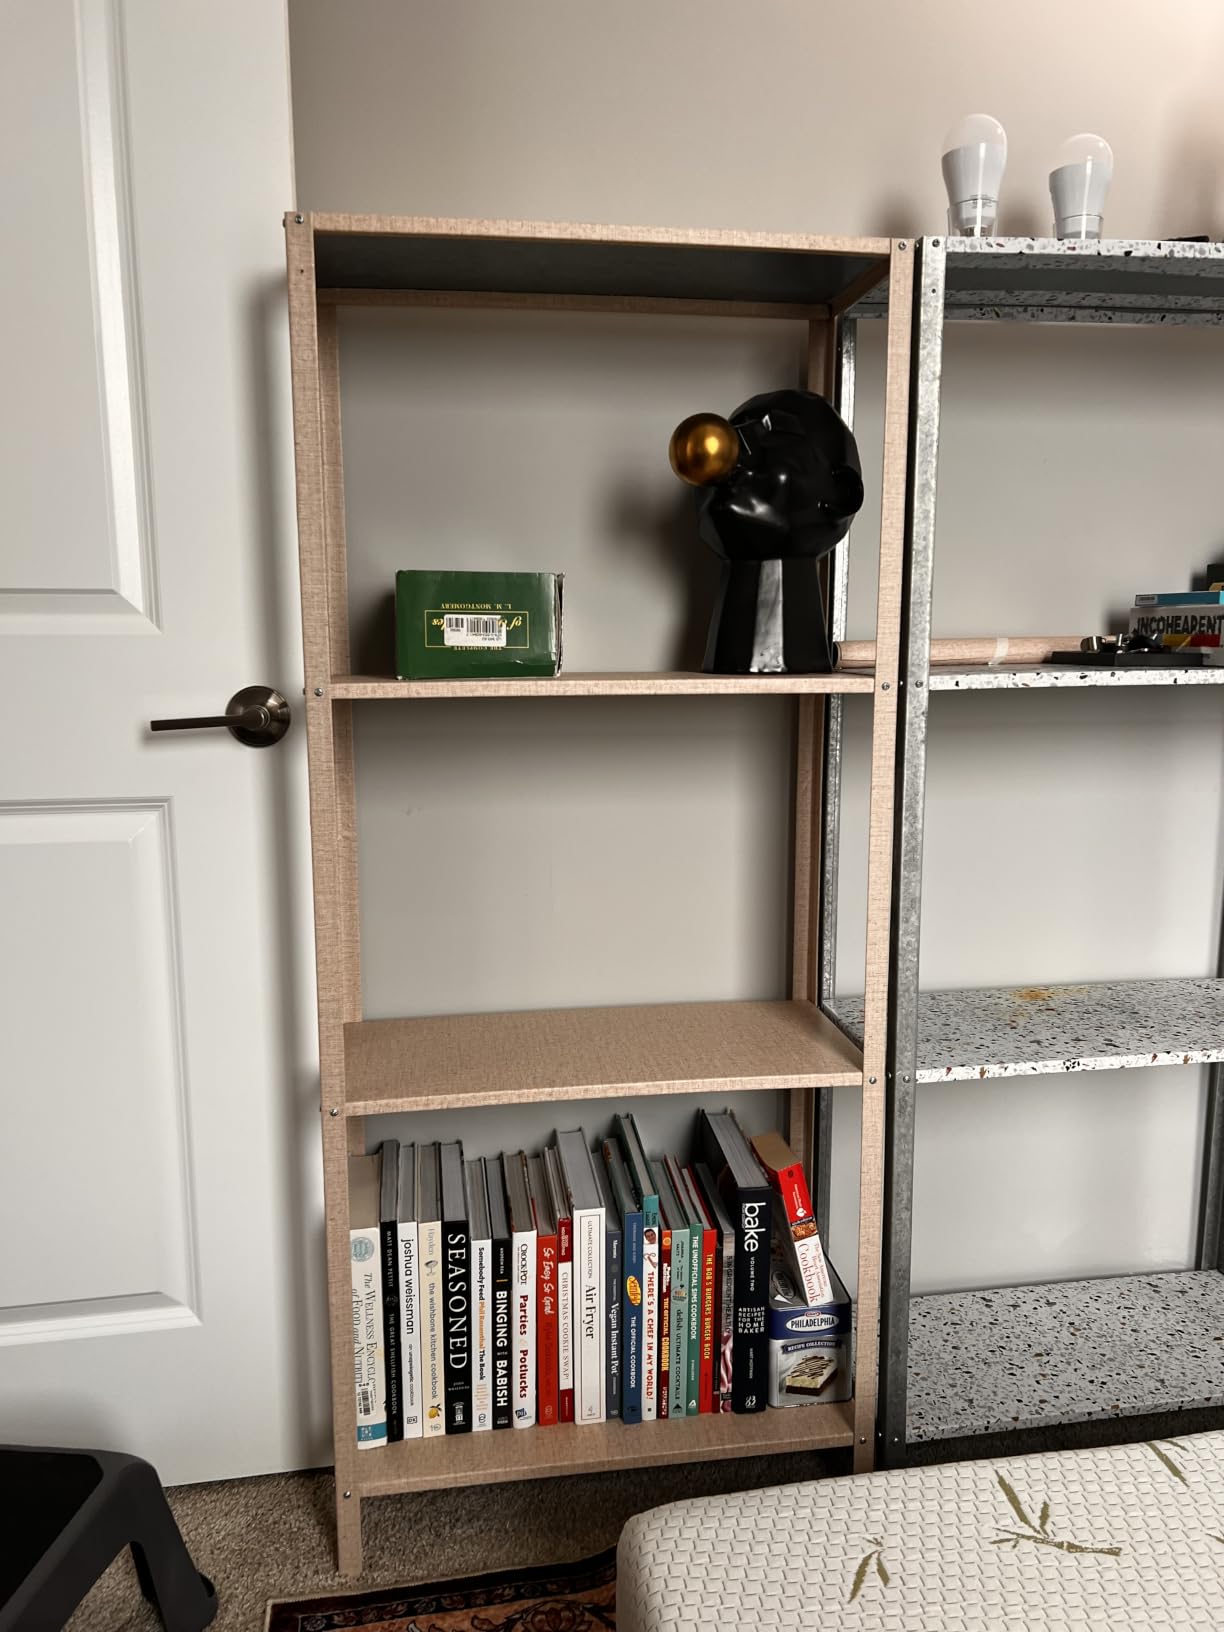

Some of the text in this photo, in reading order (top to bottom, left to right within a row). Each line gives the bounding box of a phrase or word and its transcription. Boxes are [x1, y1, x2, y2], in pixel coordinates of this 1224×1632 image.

[441, 602, 492, 610] MONTGOMERY
[744, 1202, 767, 1252] bake
[364, 1273, 373, 1288] The
[477, 1247, 486, 1284] Somebody
[540, 1247, 555, 1315] So Easy So Good
[705, 1267, 713, 1286] BOB'S
[798, 1243, 821, 1303] Cookbook
[400, 1239, 416, 1335] joshua weissman
[448, 1233, 468, 1369] SEASONED
[561, 1271, 569, 1321] CHRISTMAS
[647, 1271, 656, 1306] THERE'S
[352, 1300, 363, 1325] FOOD
[365, 1290, 376, 1339] WELLNESS
[429, 1297, 437, 1332] wishbone
[495, 1291, 508, 1347] BINGING
[519, 1294, 529, 1336] Parties
[582, 1285, 597, 1339] Air Fryer
[609, 1303, 619, 1329] Vegan
[676, 1309, 684, 1331] delish
[690, 1304, 698, 1340] COOKBOOK
[704, 1317, 712, 1341] BURGER
[790, 1317, 835, 1329] PHILADELPHIA
[353, 1327, 362, 1345] and
[430, 1334, 438, 1362] kitchen
[479, 1315, 487, 1349] Rosenthal
[611, 1330, 619, 1359] Instant
[646, 1342, 653, 1351] IN
[787, 1343, 805, 1351] RECIPE
[646, 1354, 653, 1366] MY
[662, 1337, 670, 1371] COOKBOOK
[703, 1343, 711, 1360] BOOK
[430, 1363, 438, 1400] cookbook
[496, 1360, 508, 1406] BABISH
[519, 1349, 529, 1398] Potlucks
[646, 1368, 654, 1400] WORLD!
